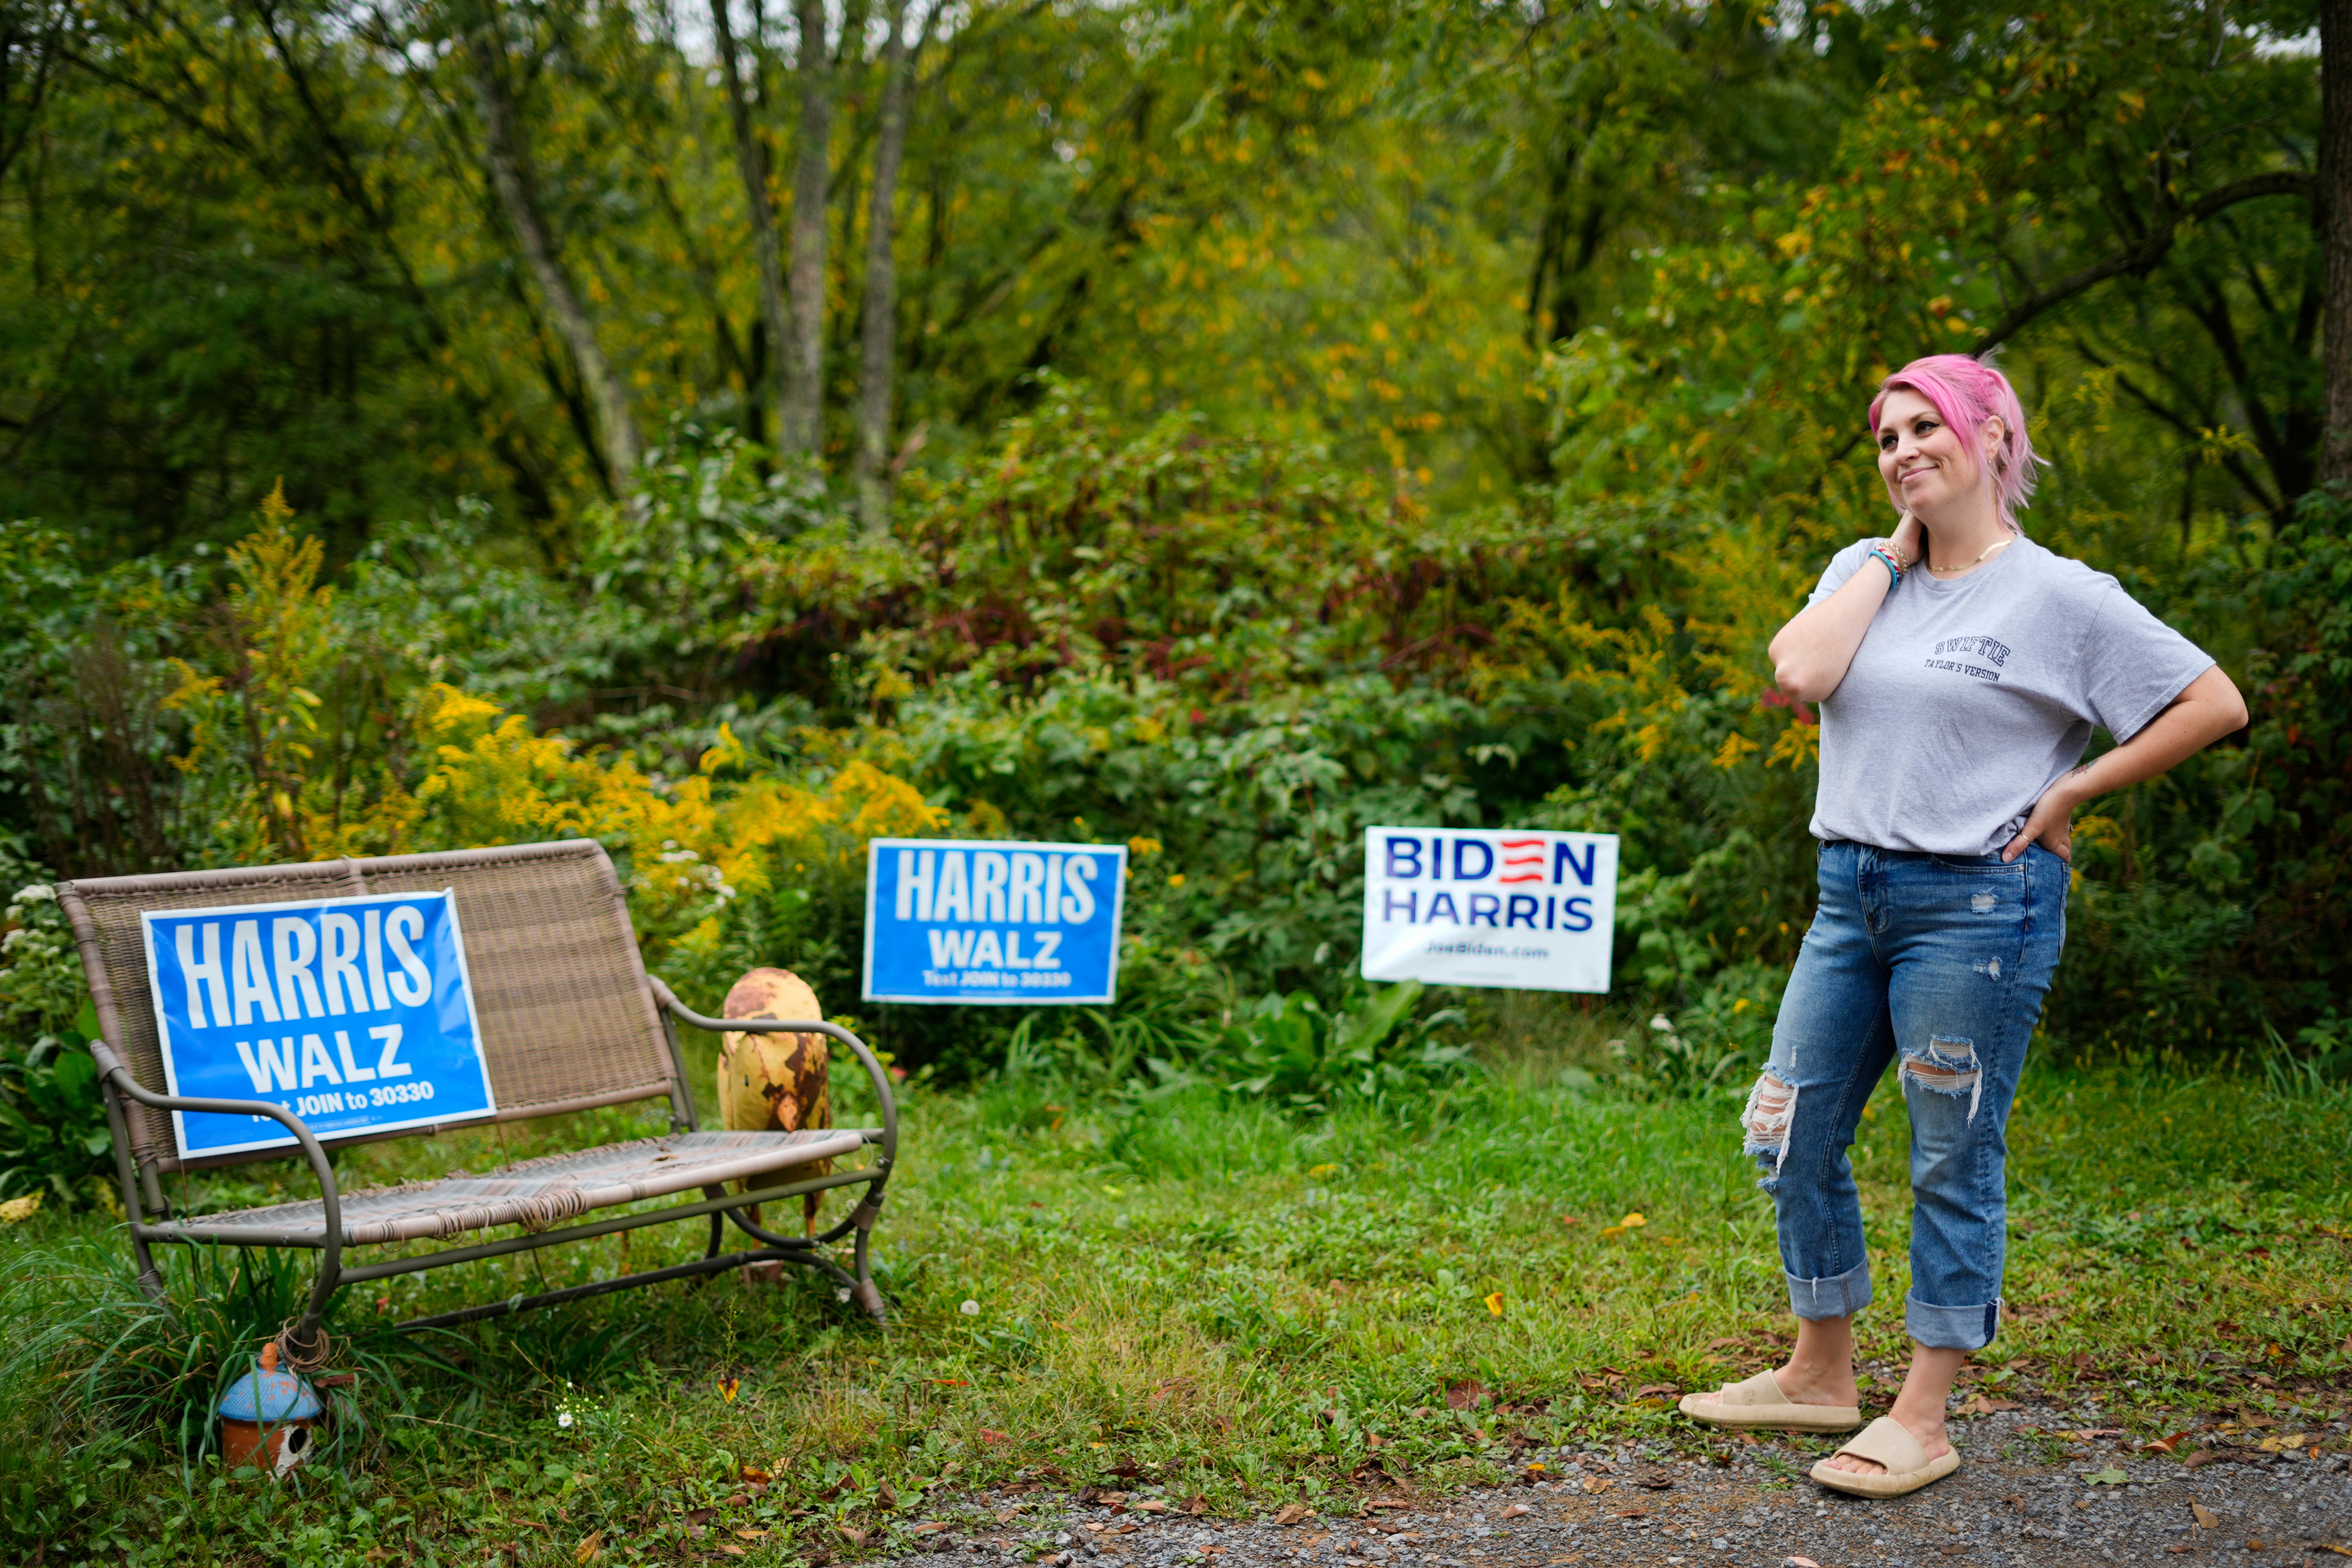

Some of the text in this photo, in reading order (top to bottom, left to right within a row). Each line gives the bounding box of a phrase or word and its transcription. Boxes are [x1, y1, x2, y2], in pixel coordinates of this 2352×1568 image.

[1924, 659, 2000, 682] TAYLOR'S VERSION
[1935, 636, 2011, 667] SWIFTIE
[1385, 837, 1595, 885] BIDEN
[895, 849, 1098, 924] HARRIS
[1384, 890, 1593, 932] HARRIS
[175, 905, 432, 1029] HARRIS
[927, 929, 1063, 969] WALZ
[1427, 941, 1549, 958] JoeBiden.com
[959, 971, 1000, 987] JOIN
[1001, 971, 1019, 988] to
[235, 1023, 412, 1094] WALZ
[296, 1091, 345, 1117] JOIN
[345, 1091, 368, 1110] to
[369, 1080, 435, 1107] 30330
